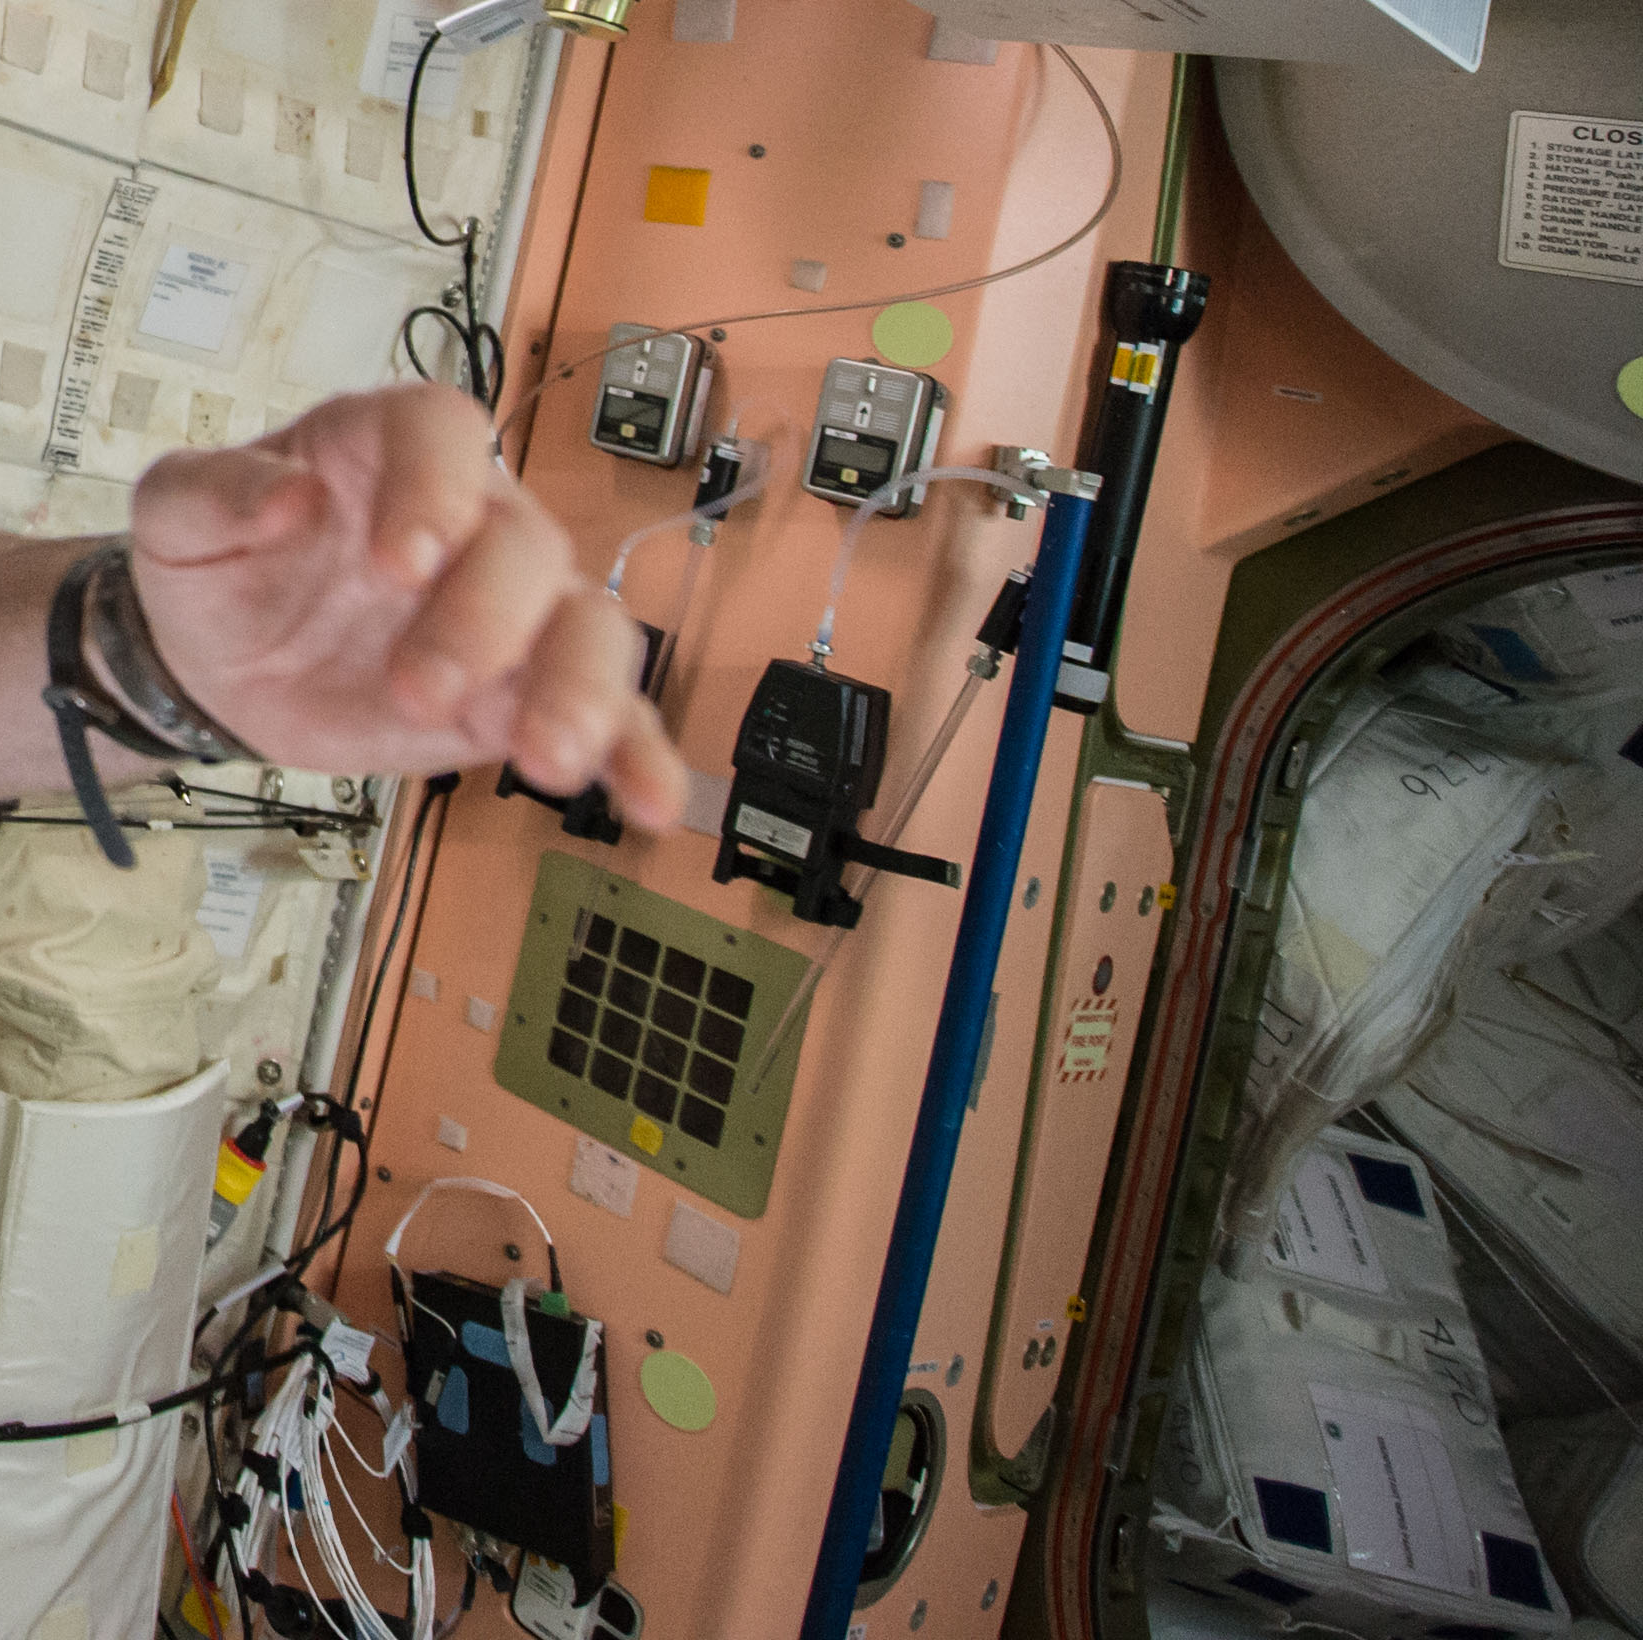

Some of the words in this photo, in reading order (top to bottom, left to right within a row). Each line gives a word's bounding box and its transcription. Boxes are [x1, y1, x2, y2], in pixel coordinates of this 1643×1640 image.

[1547, 143, 1613, 157] STOWAGE
[1546, 154, 1613, 168] STOWAGE
[1545, 164, 1589, 175] HATCH
[1544, 174, 1601, 186] ARROWS
[1543, 184, 1609, 198] PRESSURE
[1542, 194, 1603, 207] RATCHET
[1541, 204, 1585, 216] CRANK
[1590, 211, 1643, 223] HANDLE
[1540, 214, 1584, 226] CRANK
[1589, 221, 1642, 234] HANDLE
[1538, 234, 1608, 249] INDICATOR
[1538, 245, 1581, 257] CRANK
[1587, 252, 1639, 265] HANDLE
